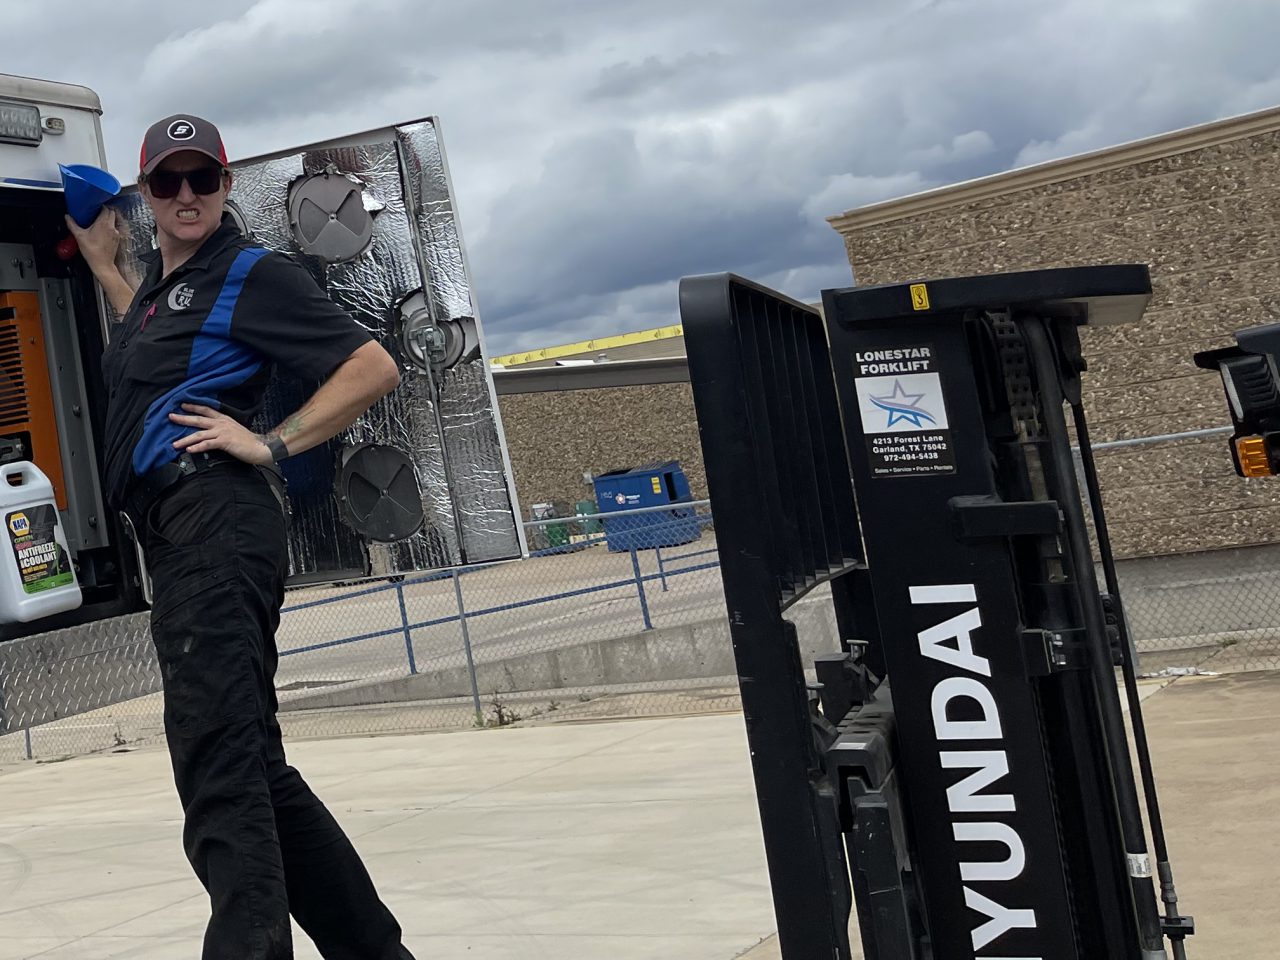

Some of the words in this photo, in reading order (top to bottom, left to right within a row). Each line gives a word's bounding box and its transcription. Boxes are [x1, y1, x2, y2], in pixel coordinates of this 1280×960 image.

[855, 347, 931, 363] LONESTAR
[860, 360, 930, 375] FORKLIFT
[872, 437, 893, 445] 4213
[894, 435, 921, 444] Forest
[872, 445, 908, 454] Garland,
[922, 443, 947, 451] 75042
[883, 452, 939, 462] 972-494-5438
[13, 518, 28, 530] NAPA
[18, 541, 56, 560] ANTIFREEZE
[908, 583, 1042, 960] YUNDAI
